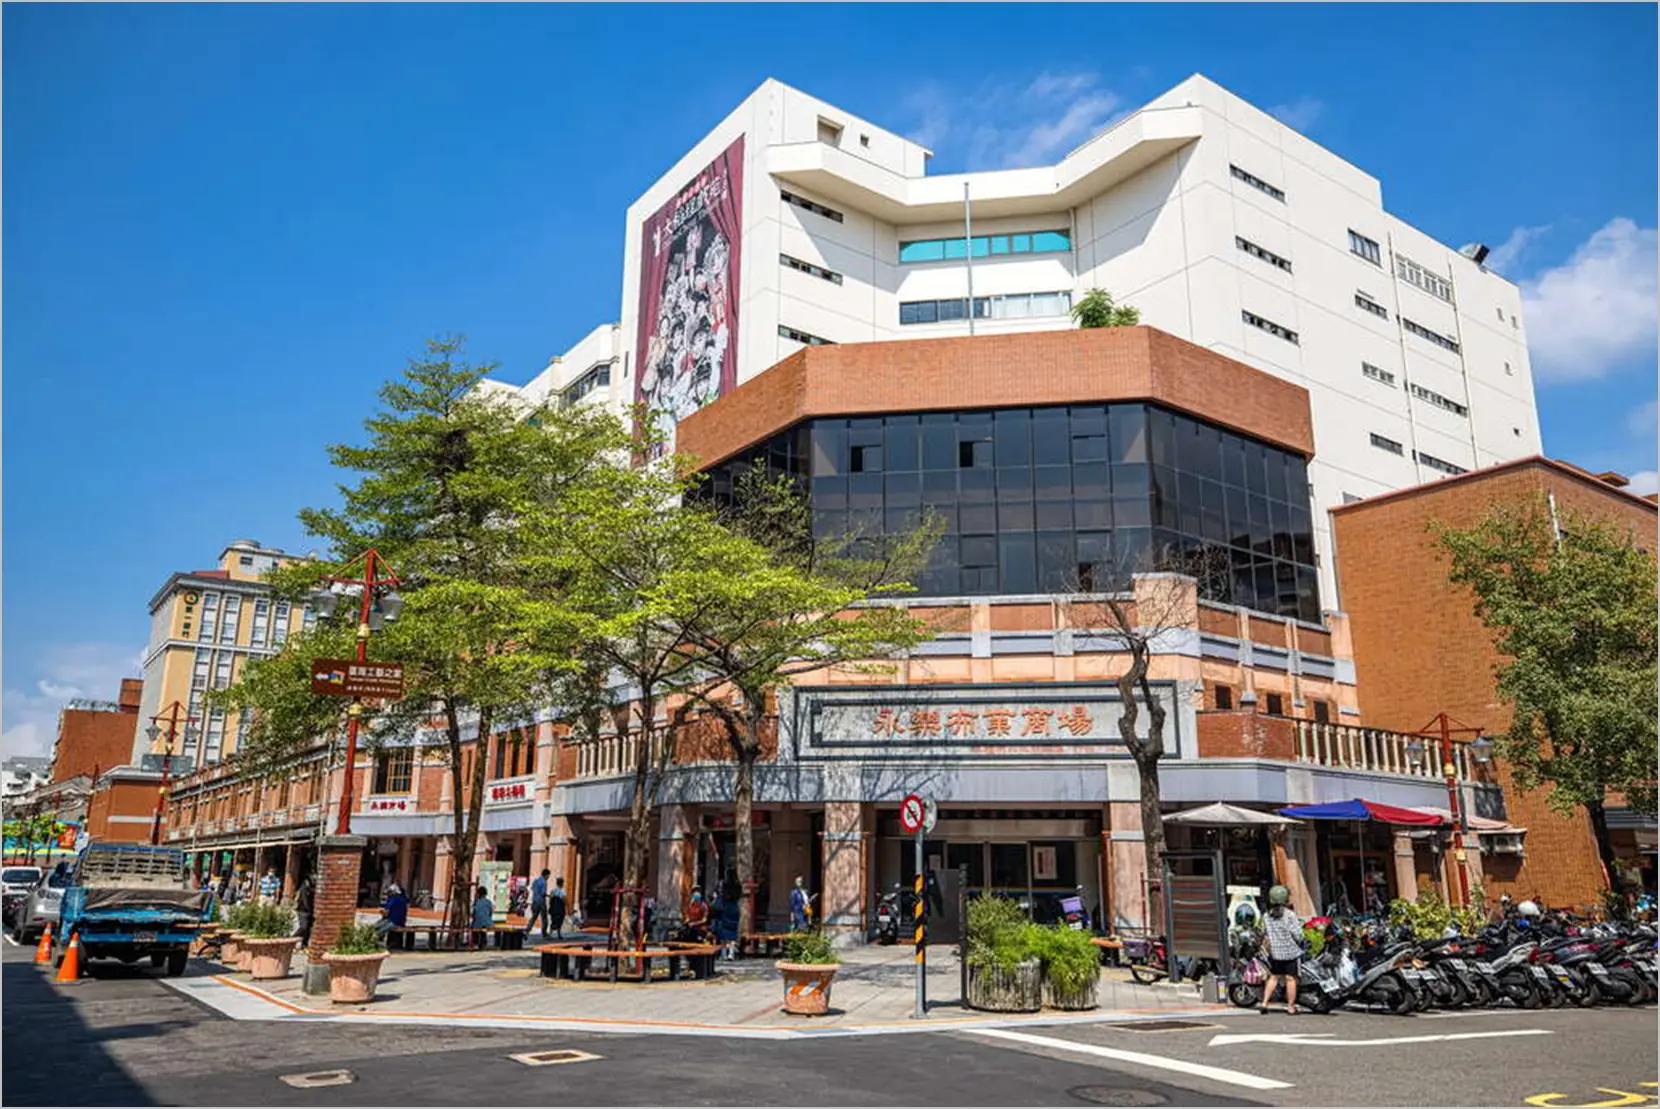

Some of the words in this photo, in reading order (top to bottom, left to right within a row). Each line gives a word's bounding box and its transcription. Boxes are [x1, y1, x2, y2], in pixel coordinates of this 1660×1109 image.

[872, 706, 1094, 737] 永樂布業商場
